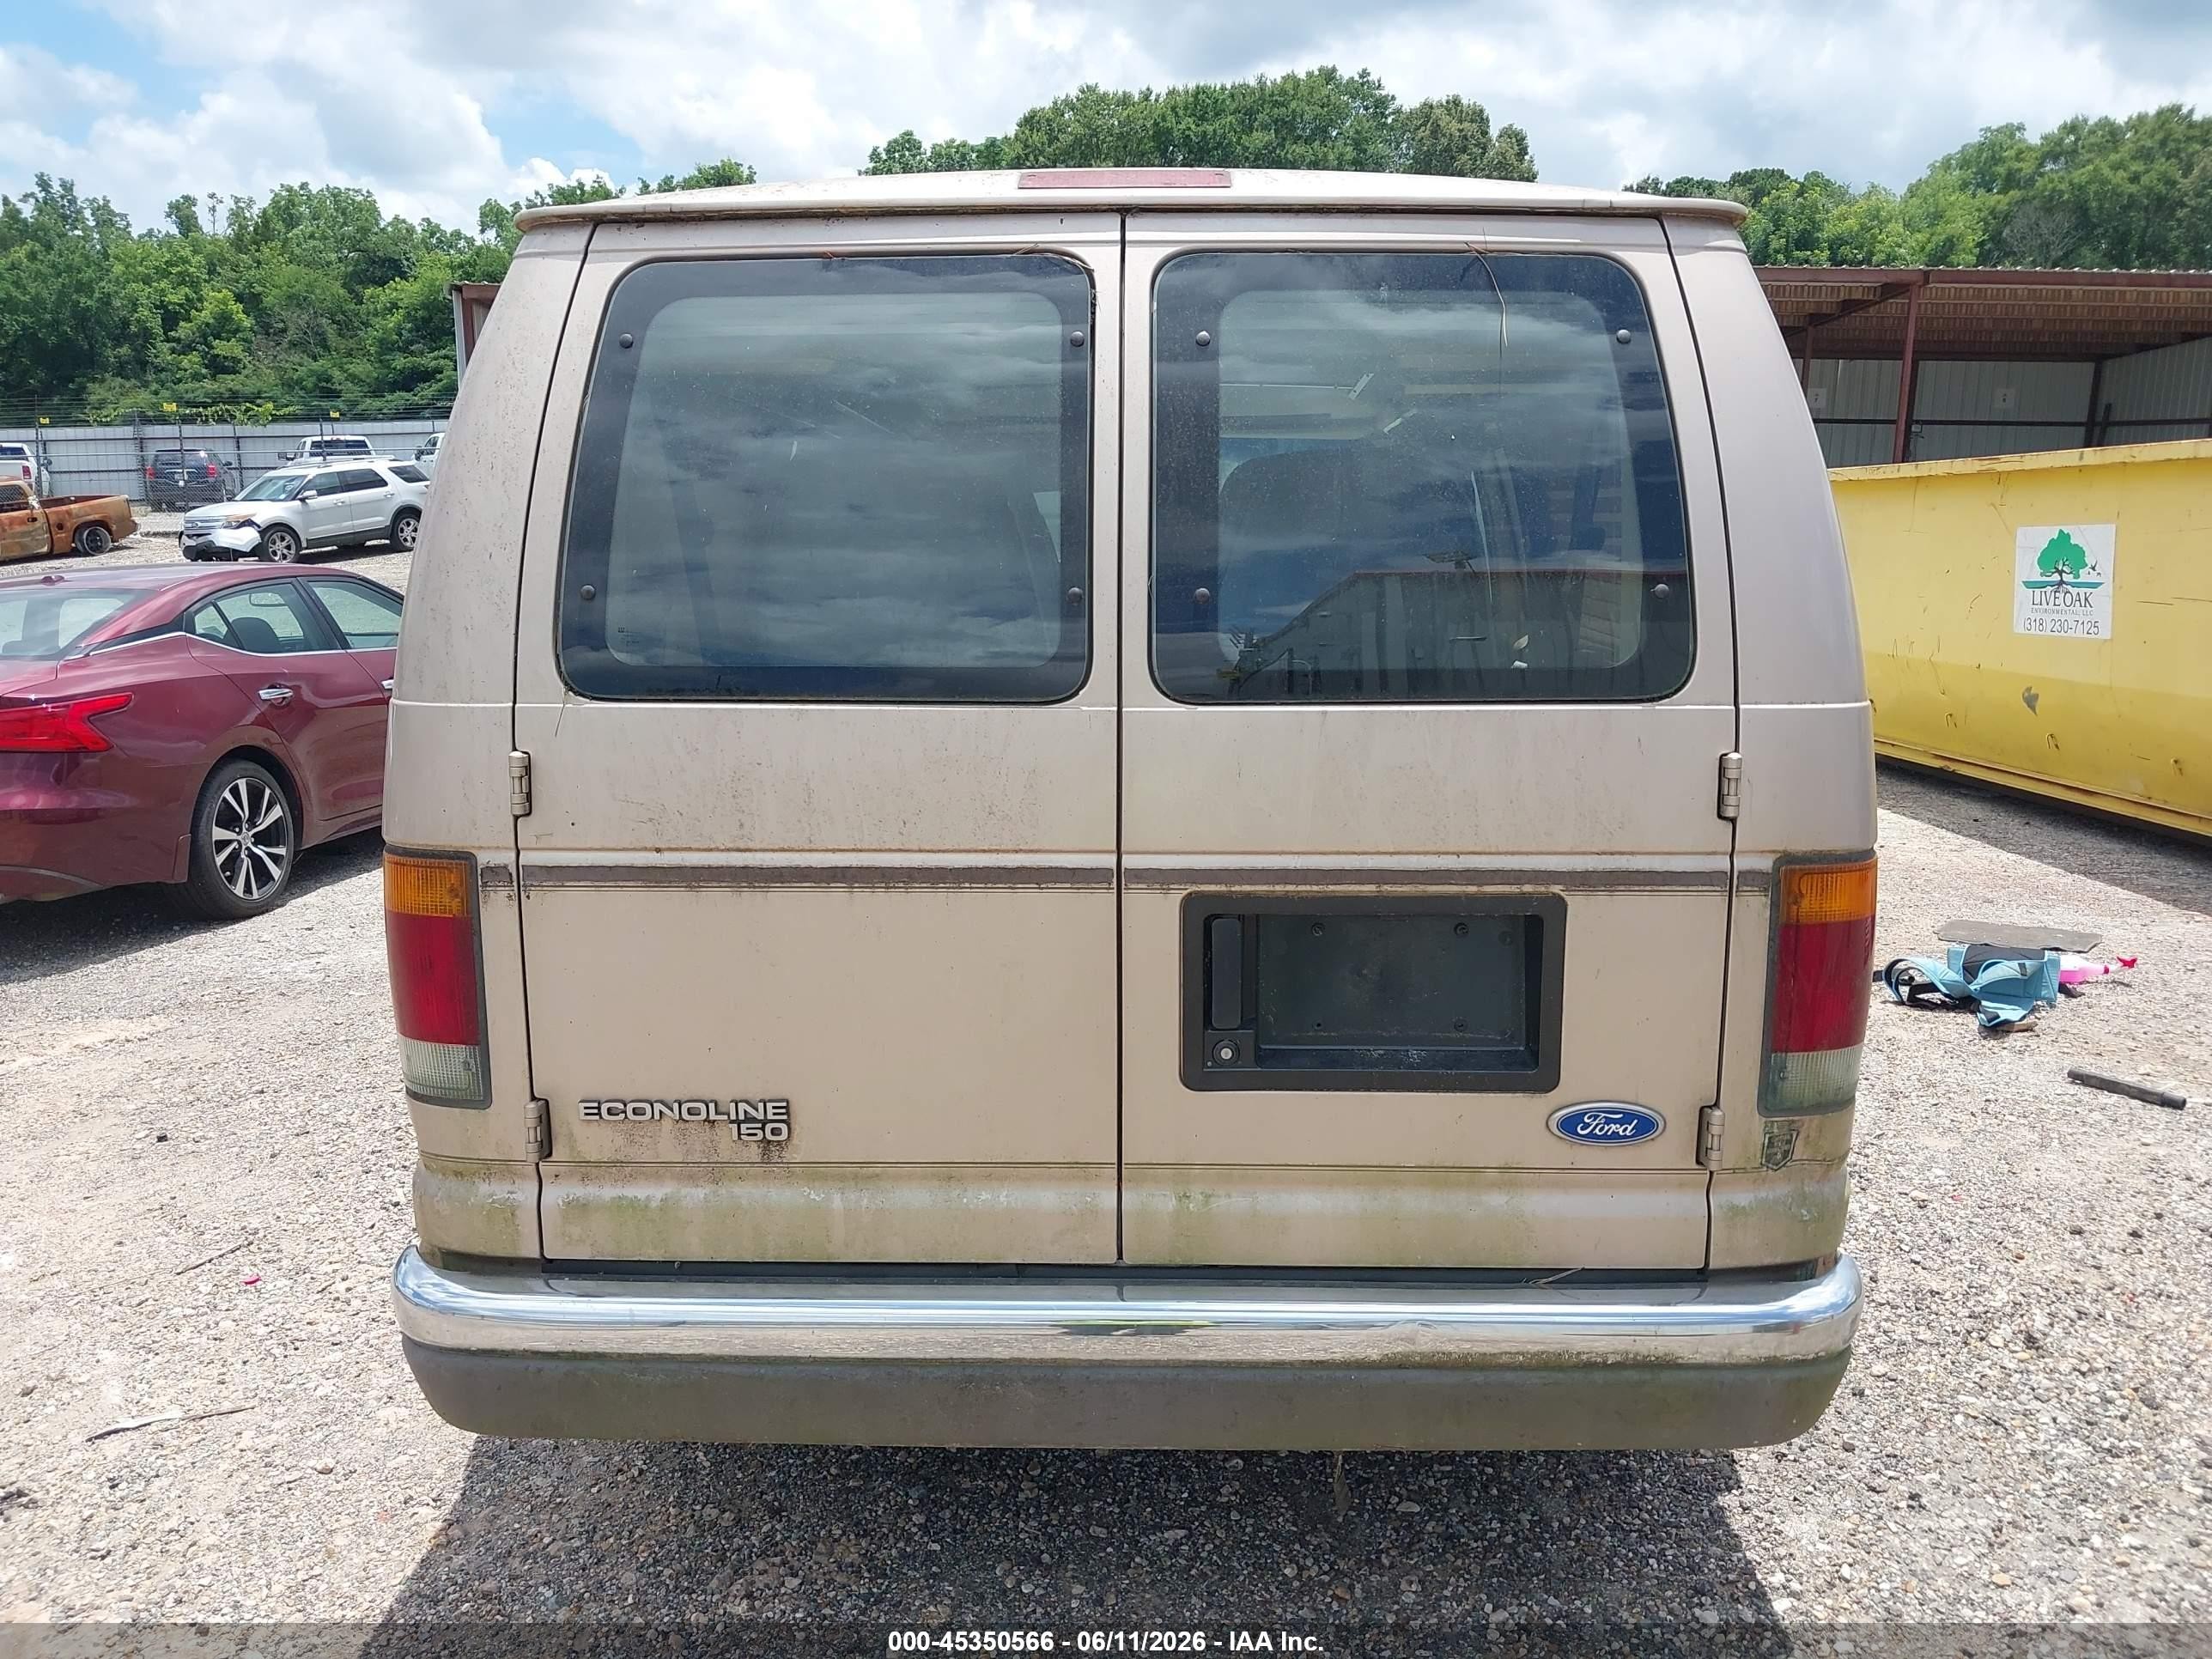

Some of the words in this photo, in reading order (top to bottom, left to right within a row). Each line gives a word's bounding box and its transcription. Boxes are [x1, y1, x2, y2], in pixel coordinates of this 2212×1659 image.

[2031, 590, 2061, 607] LIVE
[2063, 591, 2094, 609] OAK
[2023, 617, 2047, 633] (318)
[2050, 618, 2100, 635] 230-7125
[578, 1099, 789, 1121] ECONOLINE
[729, 1121, 789, 1141] 150
[1577, 1112, 1638, 1136] Ford
